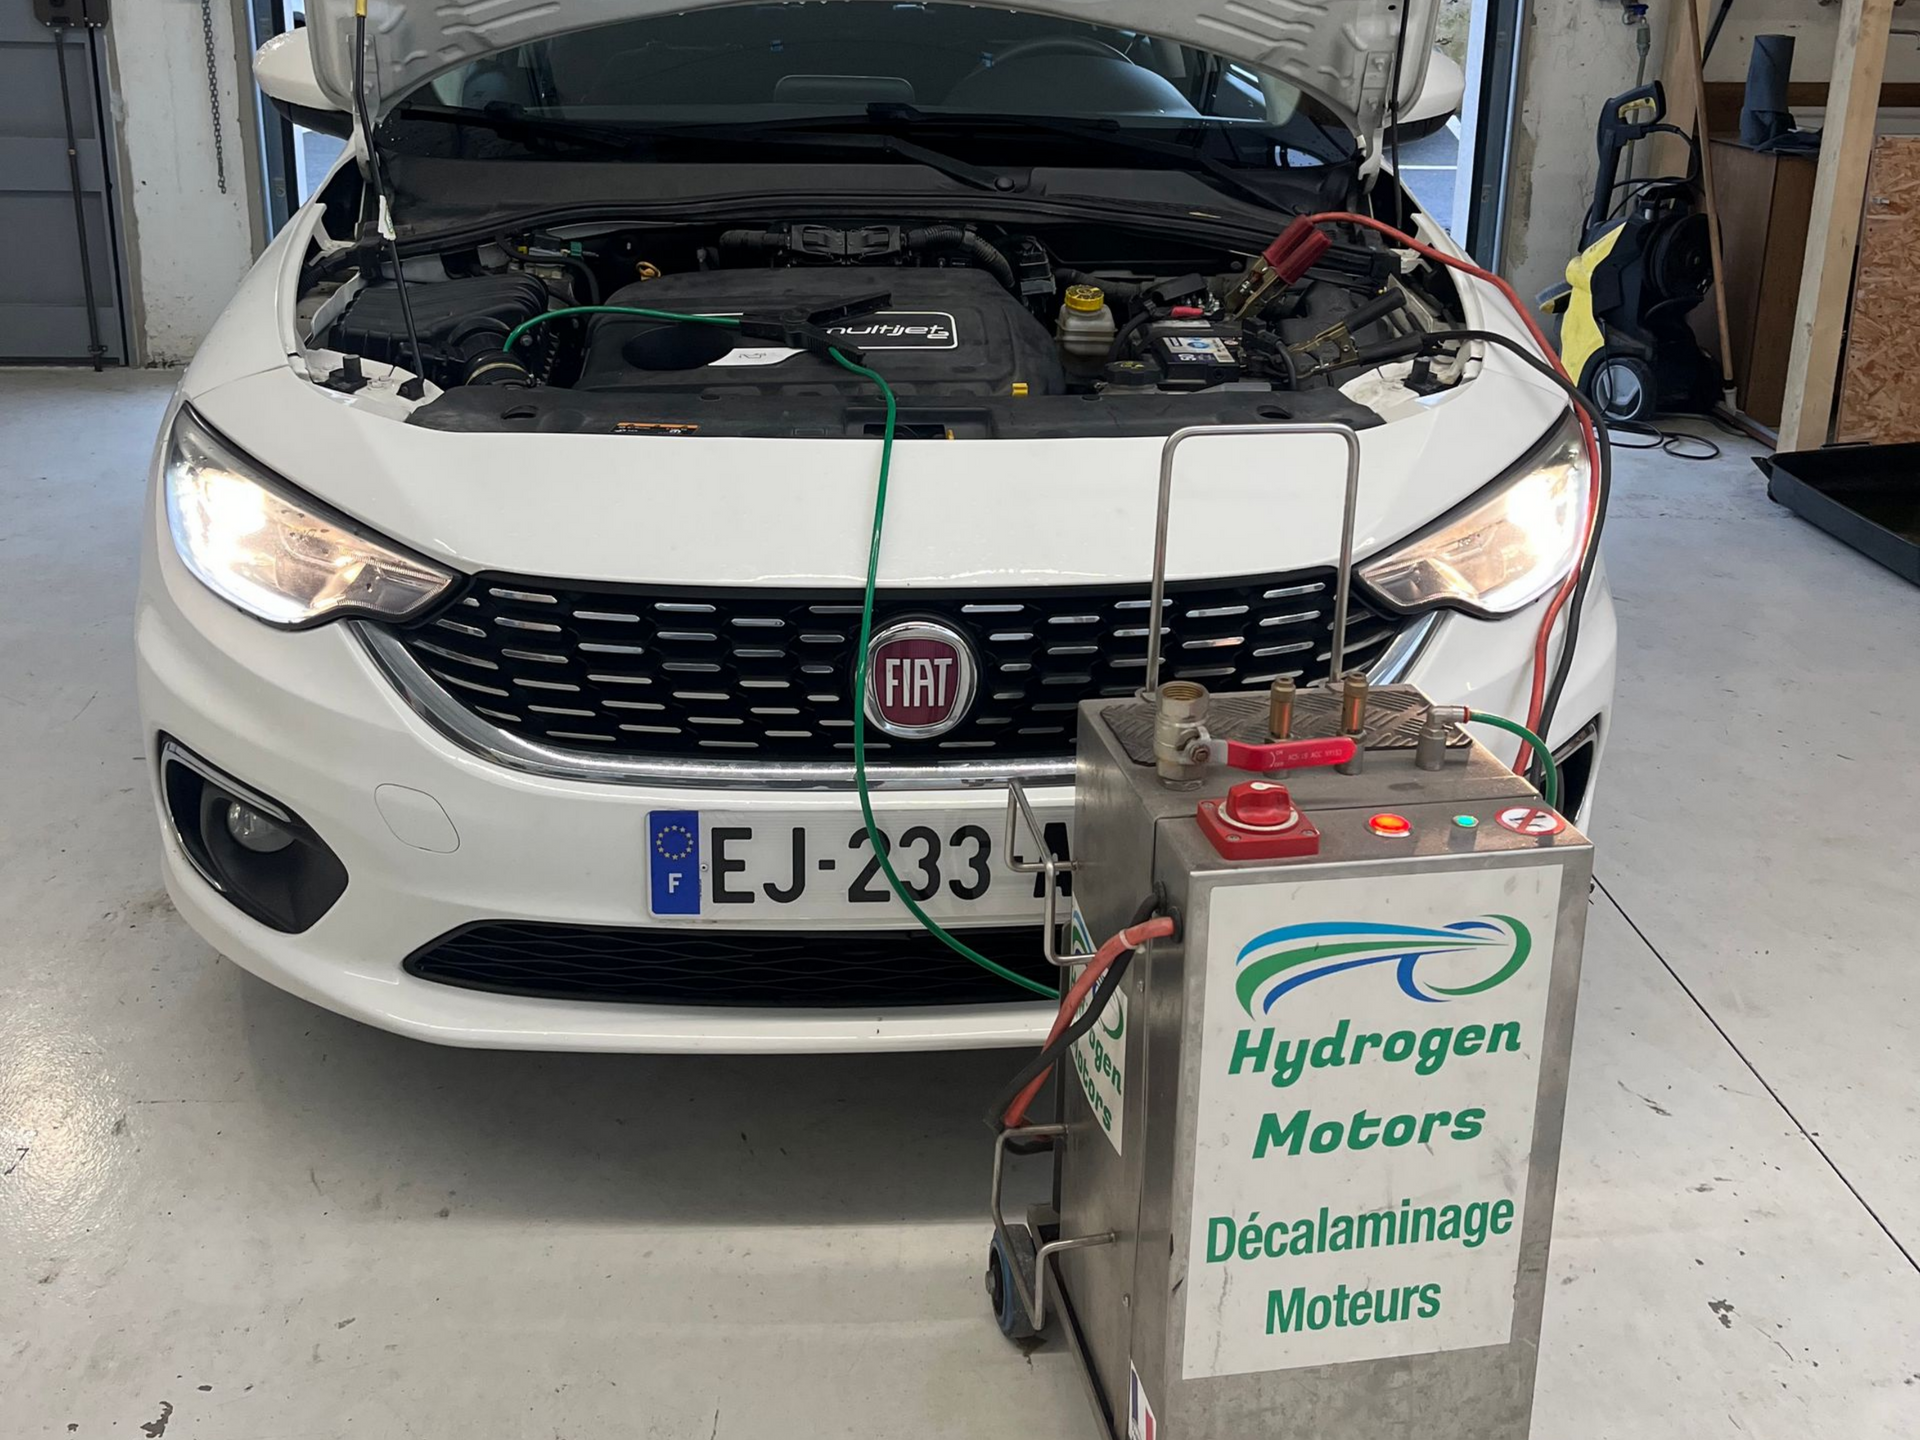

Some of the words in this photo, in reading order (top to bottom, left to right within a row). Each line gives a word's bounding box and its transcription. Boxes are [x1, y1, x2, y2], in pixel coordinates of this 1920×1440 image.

[885, 657, 953, 708] FIAT
[668, 873, 682, 894] F
[1228, 1019, 1522, 1088] Hydrogen
[1252, 1107, 1486, 1159] Motors
[1206, 1198, 1514, 1263] Décalaminage
[1265, 1283, 1441, 1335] Moteurs
